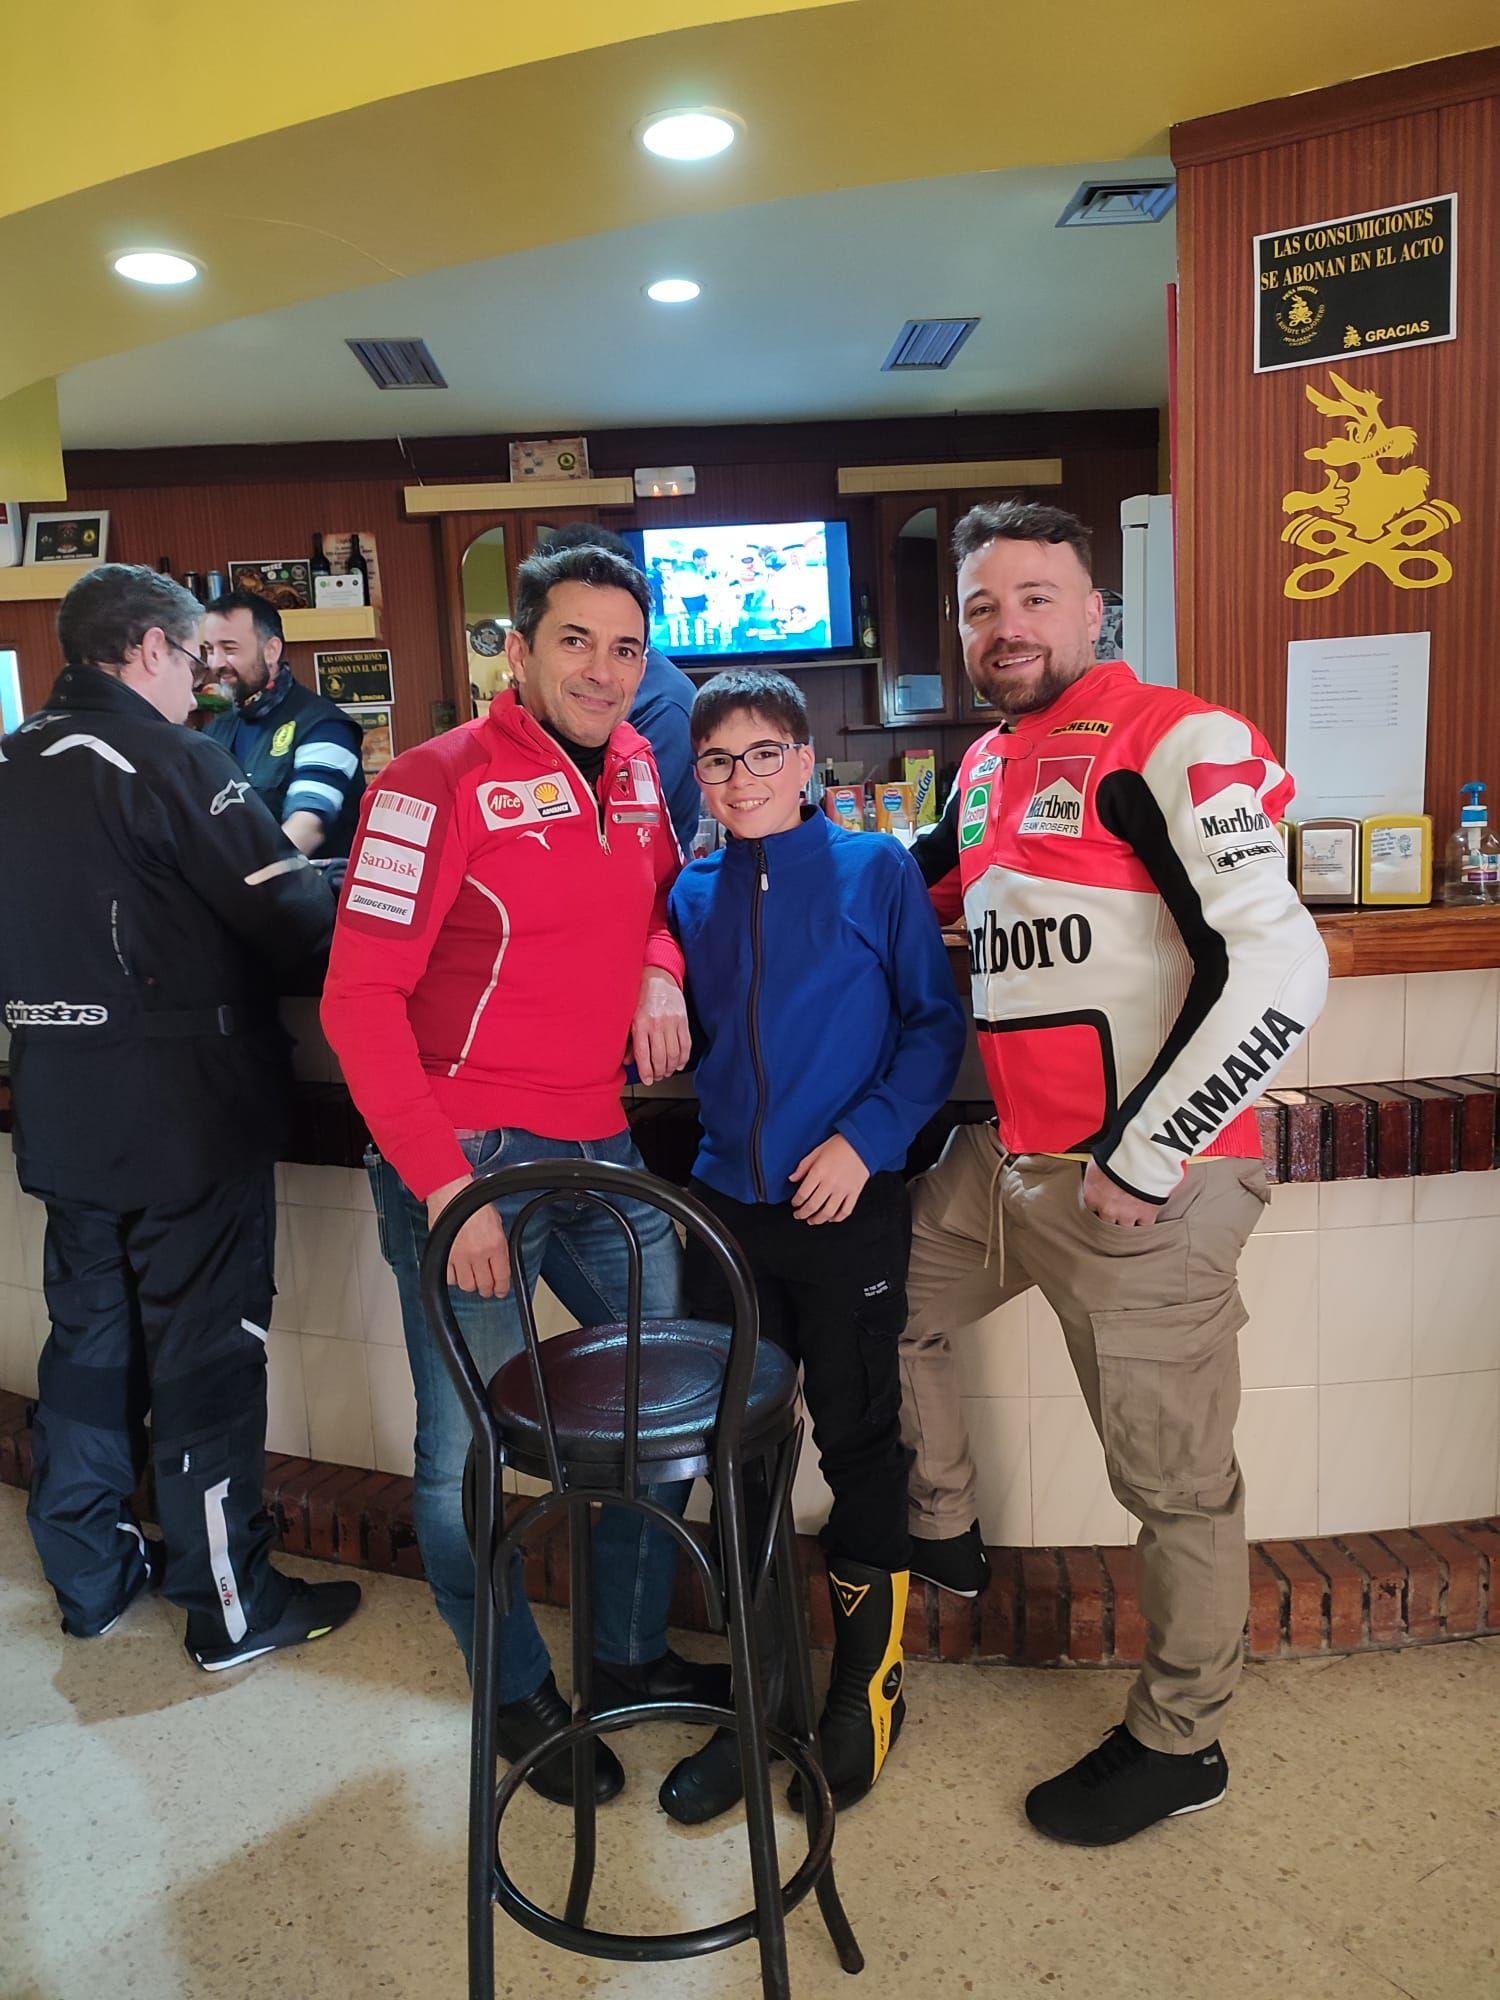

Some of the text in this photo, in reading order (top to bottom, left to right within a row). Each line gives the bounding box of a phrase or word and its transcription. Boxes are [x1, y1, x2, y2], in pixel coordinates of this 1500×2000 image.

[1273, 206, 1434, 258] LAS CONSUMICIONES
[1260, 235, 1444, 291] SE ABONAN EN EL ACTO
[1365, 320, 1430, 343] GRACIAS
[490, 794, 521, 812] Alice
[1026, 794, 1080, 820] Marlboro
[1022, 821, 1079, 835] TEAM ROBERTS
[360, 851, 418, 878] SanDisk
[352, 894, 408, 916] BRIDGESTONE
[967, 909, 1092, 976] arlboro
[1150, 1006, 1306, 1157] YAMAHA
